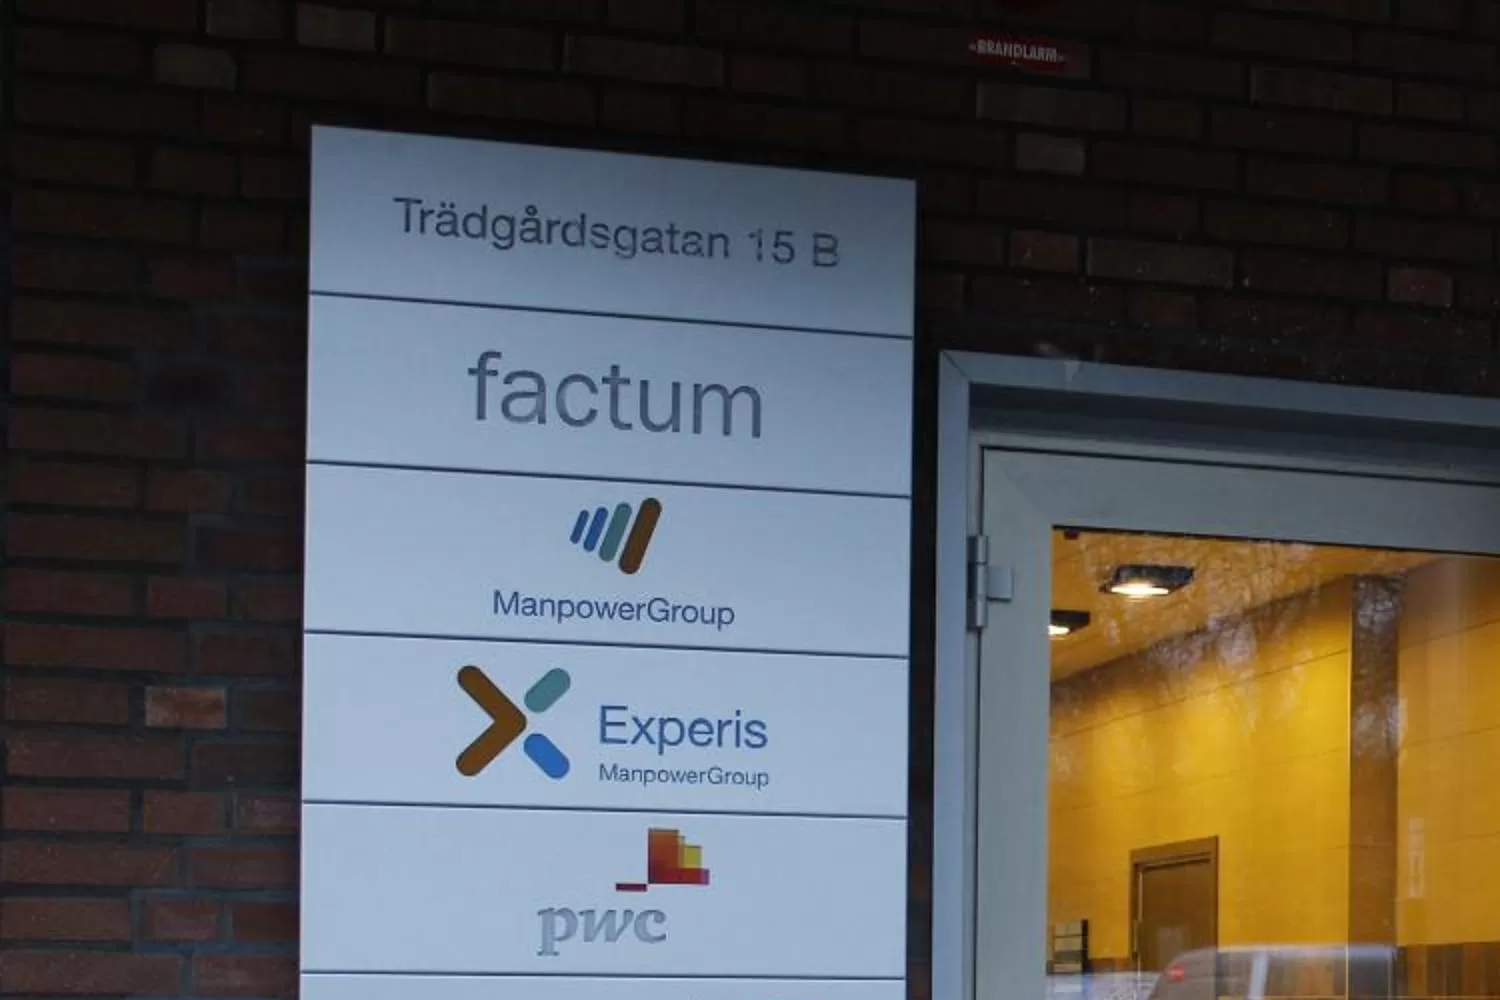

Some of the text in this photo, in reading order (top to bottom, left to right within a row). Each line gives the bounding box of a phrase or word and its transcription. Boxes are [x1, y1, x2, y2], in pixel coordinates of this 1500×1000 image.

[392, 197, 840, 268] Trädgårdsgatan 15 B
[467, 349, 763, 439] factum
[492, 590, 736, 631] ManpowerGroup
[599, 704, 769, 757] Experis
[599, 763, 770, 790] ManpowerGroup
[536, 906, 667, 957] pwc
